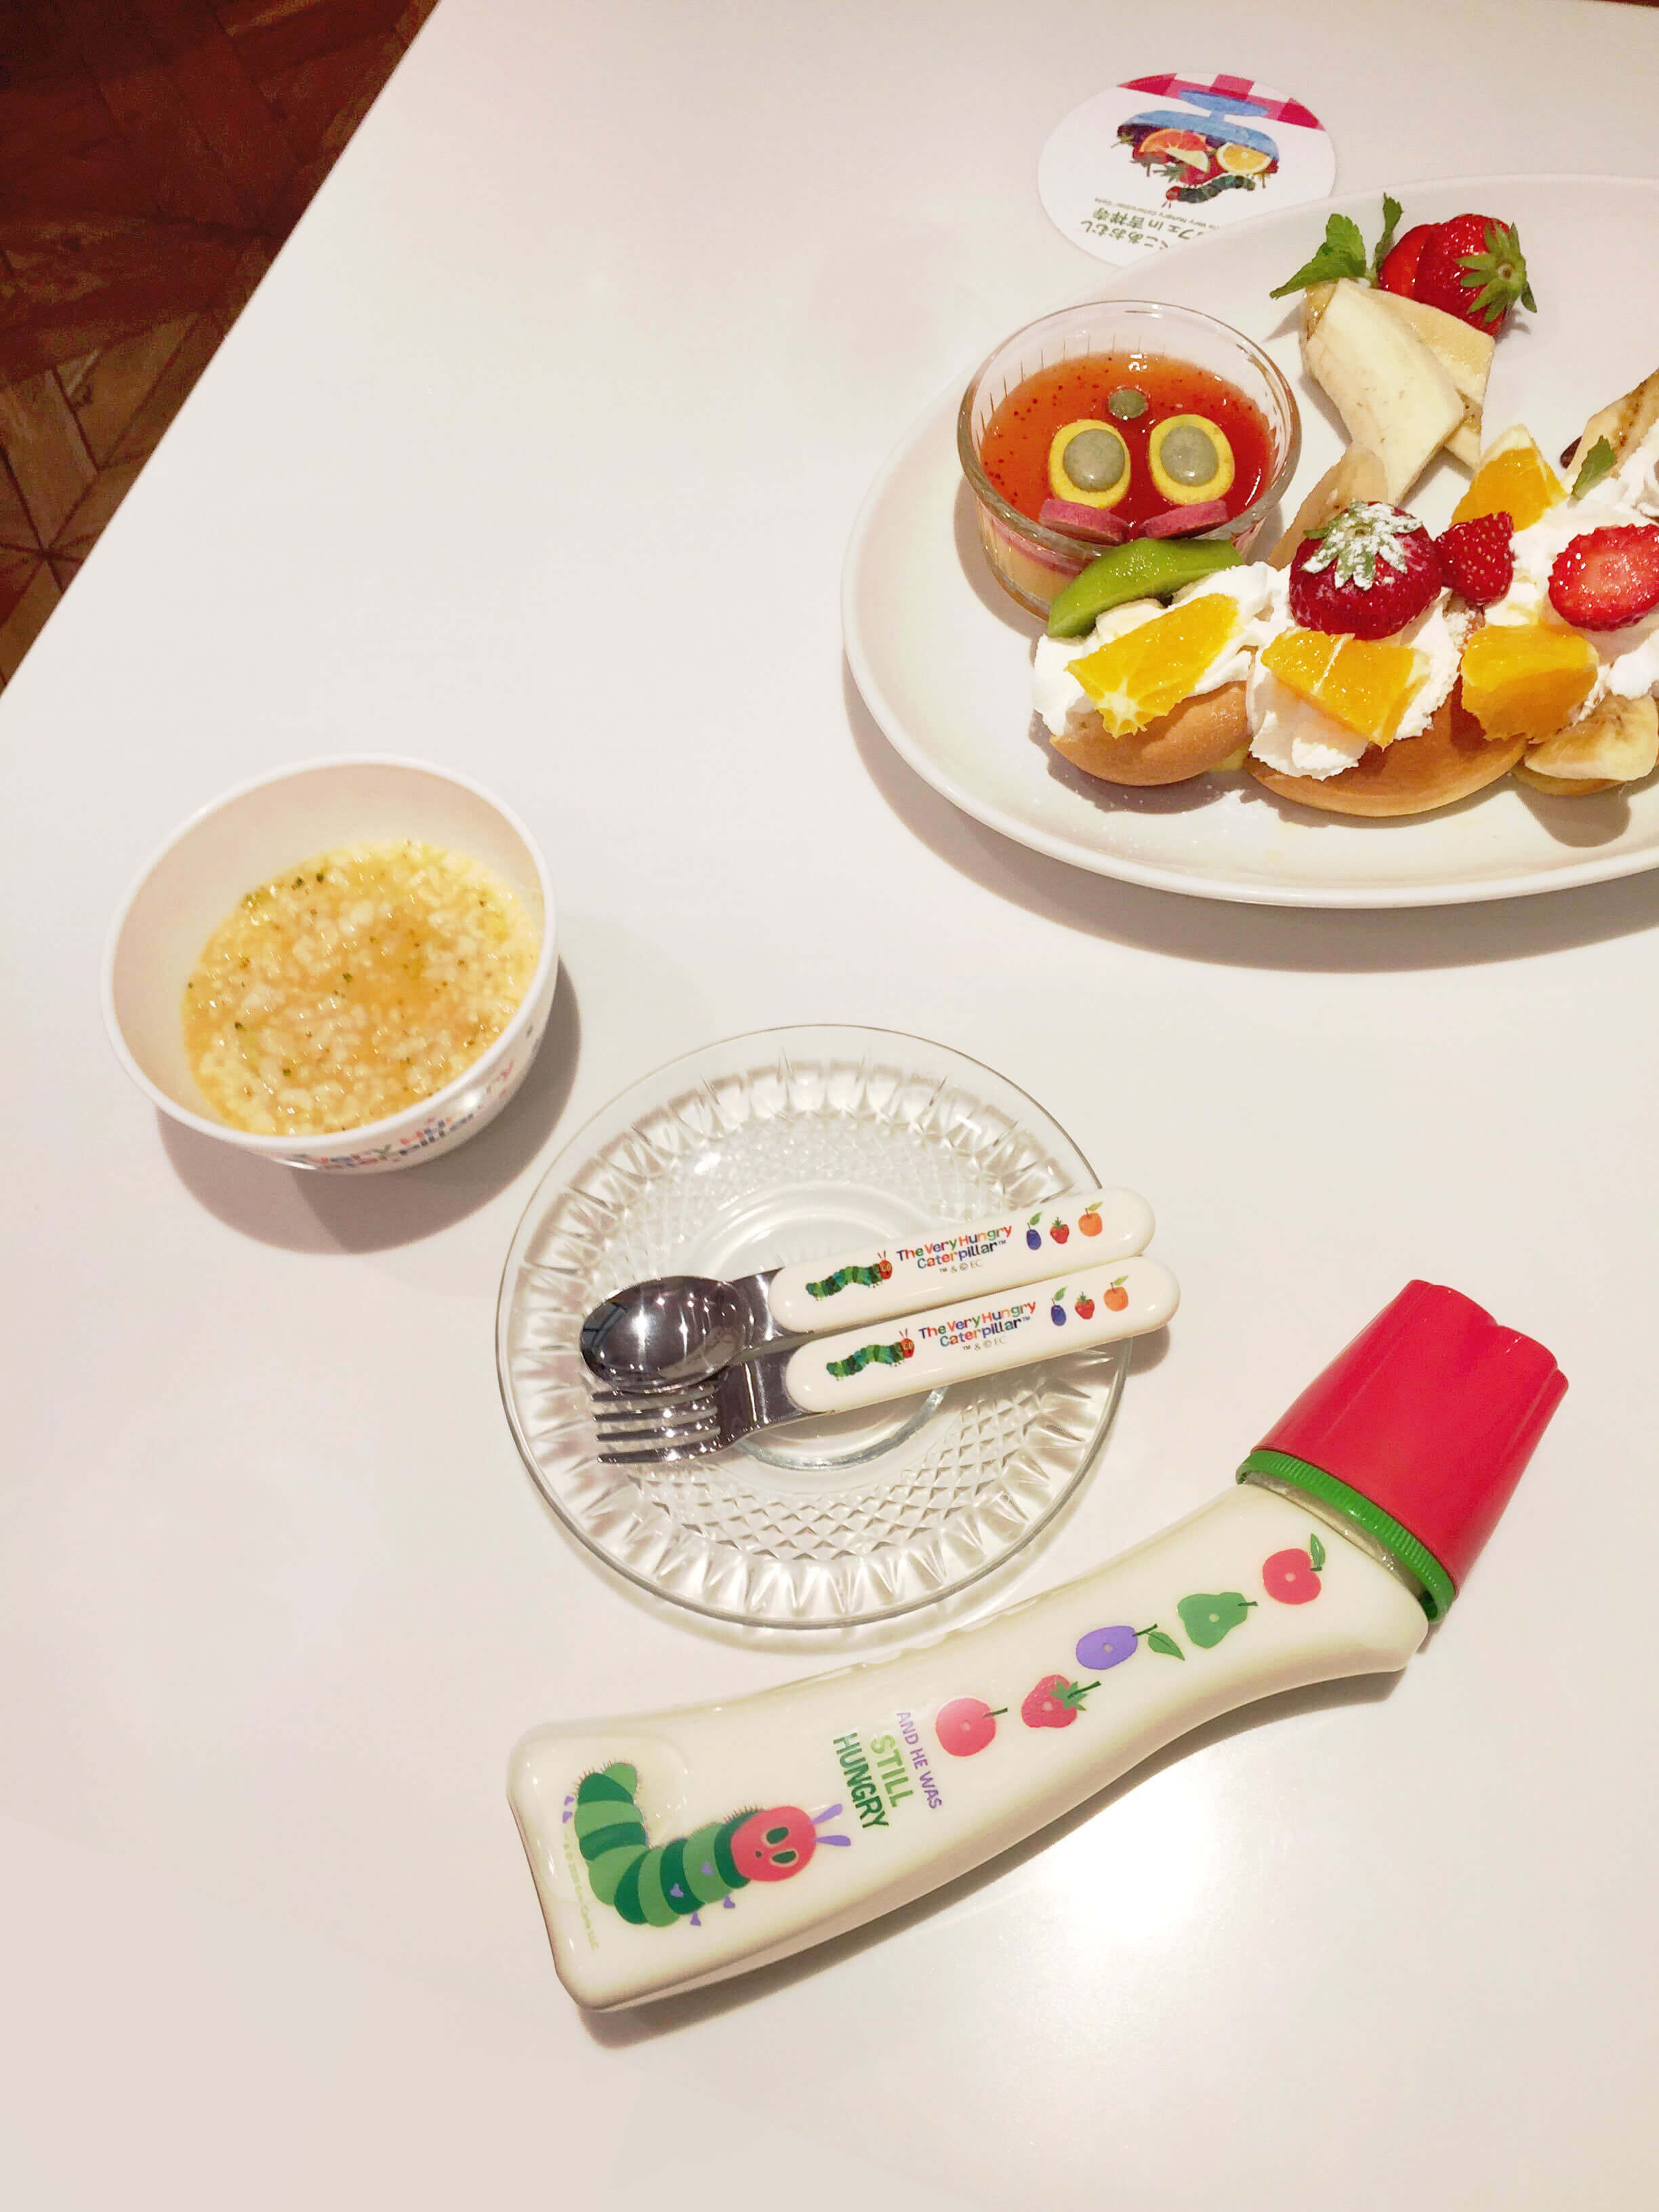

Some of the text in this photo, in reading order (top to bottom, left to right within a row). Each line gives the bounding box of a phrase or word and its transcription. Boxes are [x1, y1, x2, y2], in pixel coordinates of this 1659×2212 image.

[1167, 224, 1204, 239] フェ
[896, 1225, 1012, 1261] The Very Hungry
[918, 1301, 1036, 1339] The Very Hungry
[833, 1732, 889, 1828] HUNGRY
[870, 1734, 914, 1807] STILL
[897, 1712, 942, 1809] AND HE WAS
